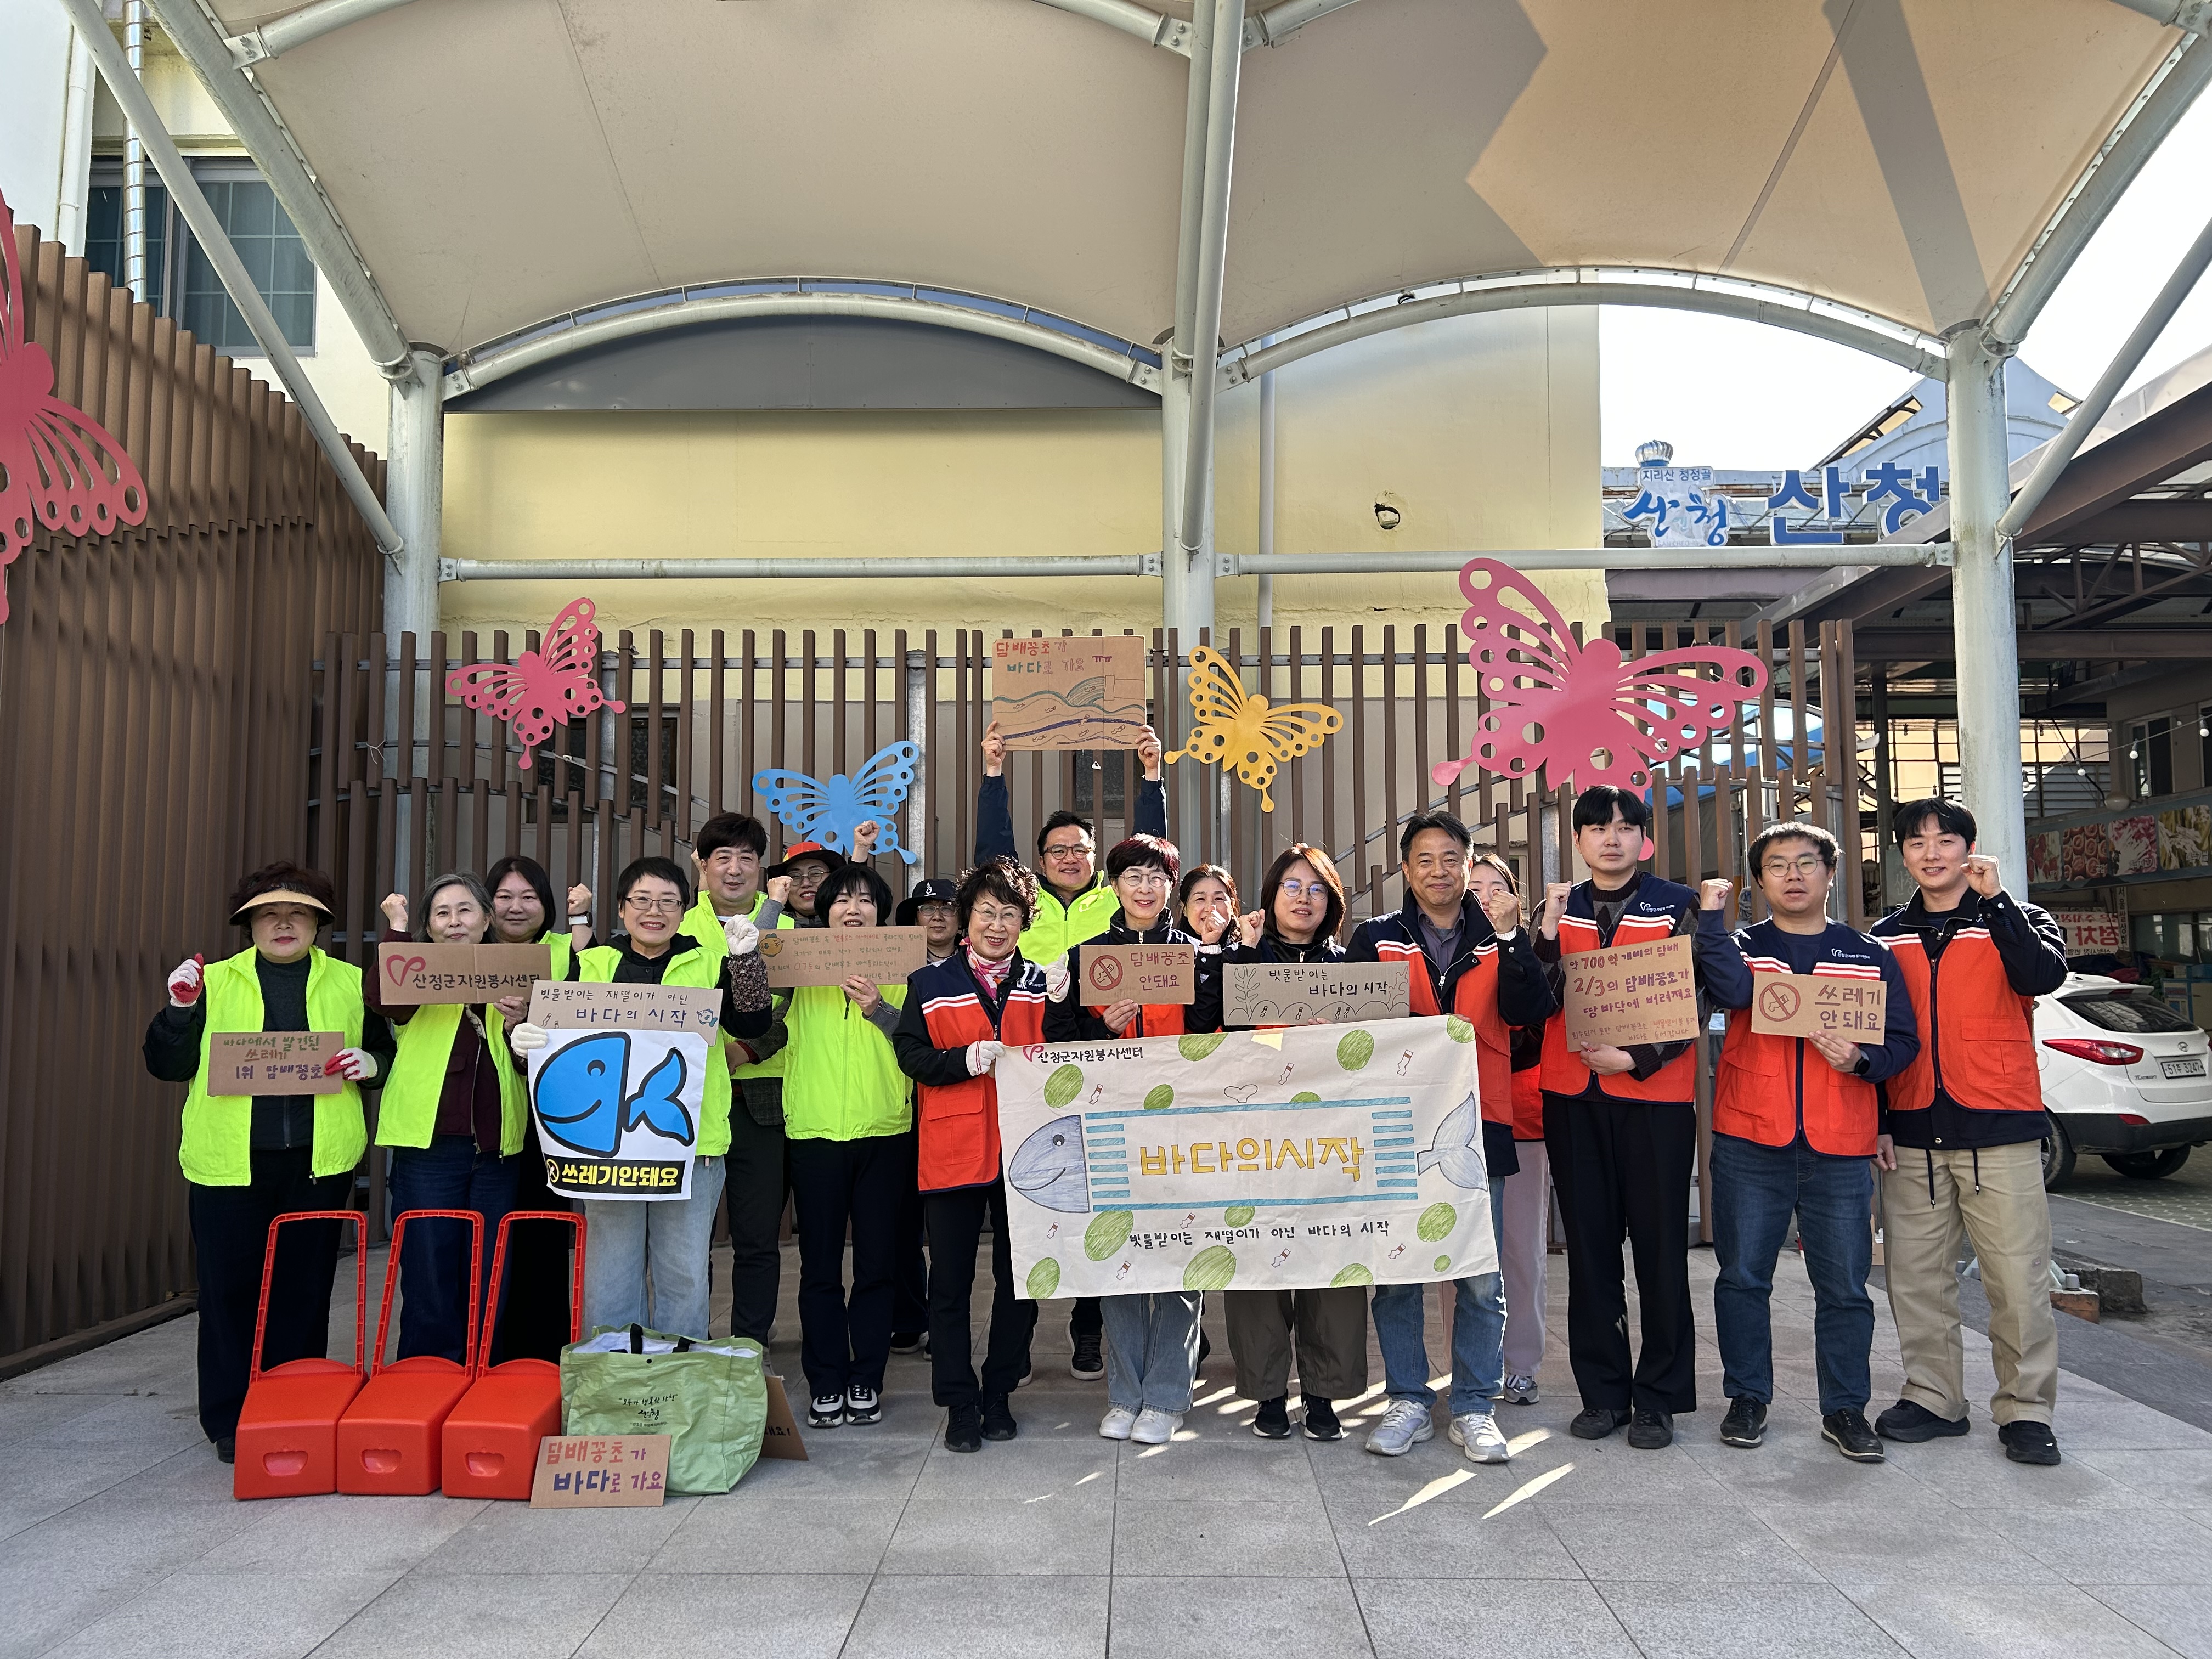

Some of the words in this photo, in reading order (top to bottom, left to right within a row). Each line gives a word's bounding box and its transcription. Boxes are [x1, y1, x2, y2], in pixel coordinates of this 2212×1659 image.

[1643, 469, 1674, 482] 지리산
[1679, 469, 1711, 481] 청정골
[1007, 661, 1053, 674] 바다로
[1062, 658, 1085, 672] 가요
[793, 935, 820, 945] 담배꽁초
[1657, 943, 1679, 957] 담배
[1130, 951, 1190, 967] 담배꽁초
[412, 973, 541, 991] 산청군자원봉사센터
[1139, 974, 1180, 991] 안돼요
[1269, 968, 1328, 983] 빗물받이는
[540, 989, 594, 1001] 빗물받이는
[605, 989, 655, 1002] 재떨이가
[667, 992, 688, 1006] 아닌
[1309, 981, 1357, 997] 바다의
[1364, 981, 1389, 995] 시작
[1815, 984, 1880, 1007] 쓰레기
[576, 1008, 637, 1023] 바다의
[648, 1009, 687, 1029] 시작
[1820, 1009, 1881, 1031] 안돼요
[223, 1036, 276, 1047] 바다에서
[282, 1035, 319, 1052] 발견된
[1628, 1032, 1649, 1041] 바다로
[244, 1048, 287, 1062] 쓰레기
[1037, 1047, 1143, 1064] 산청군자원봉사센터
[266, 1064, 323, 1081] 담배꽁초
[1139, 1137, 1365, 1182] 바다의시작
[562, 1163, 679, 1187] 쓰레기안돼요
[1130, 1231, 1193, 1250] 빗물받이는
[1205, 1227, 1260, 1245] 재떨이가
[1271, 1226, 1295, 1239] 아닌
[1308, 1223, 1351, 1237] 바다의
[1360, 1220, 1390, 1237] 시작
[553, 1469, 620, 1496] 바다로
[631, 1471, 663, 1491] 가요
